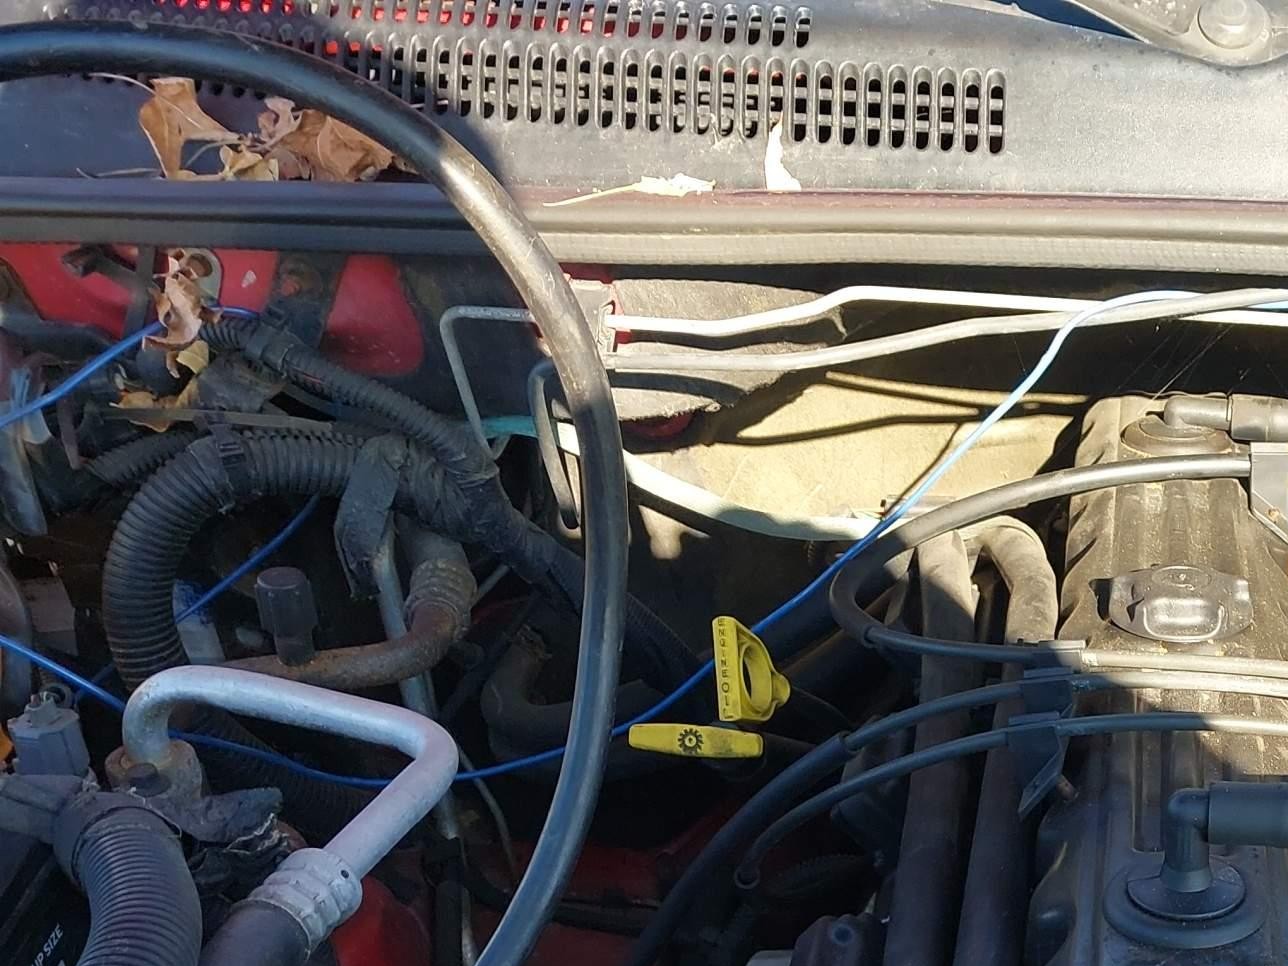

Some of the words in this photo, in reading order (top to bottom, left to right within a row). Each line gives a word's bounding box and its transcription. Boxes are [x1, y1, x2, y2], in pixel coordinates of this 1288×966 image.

[717, 617, 729, 678] ENGINE
[721, 681, 734, 720] OIL
[43, 923, 65, 957] SIZE
